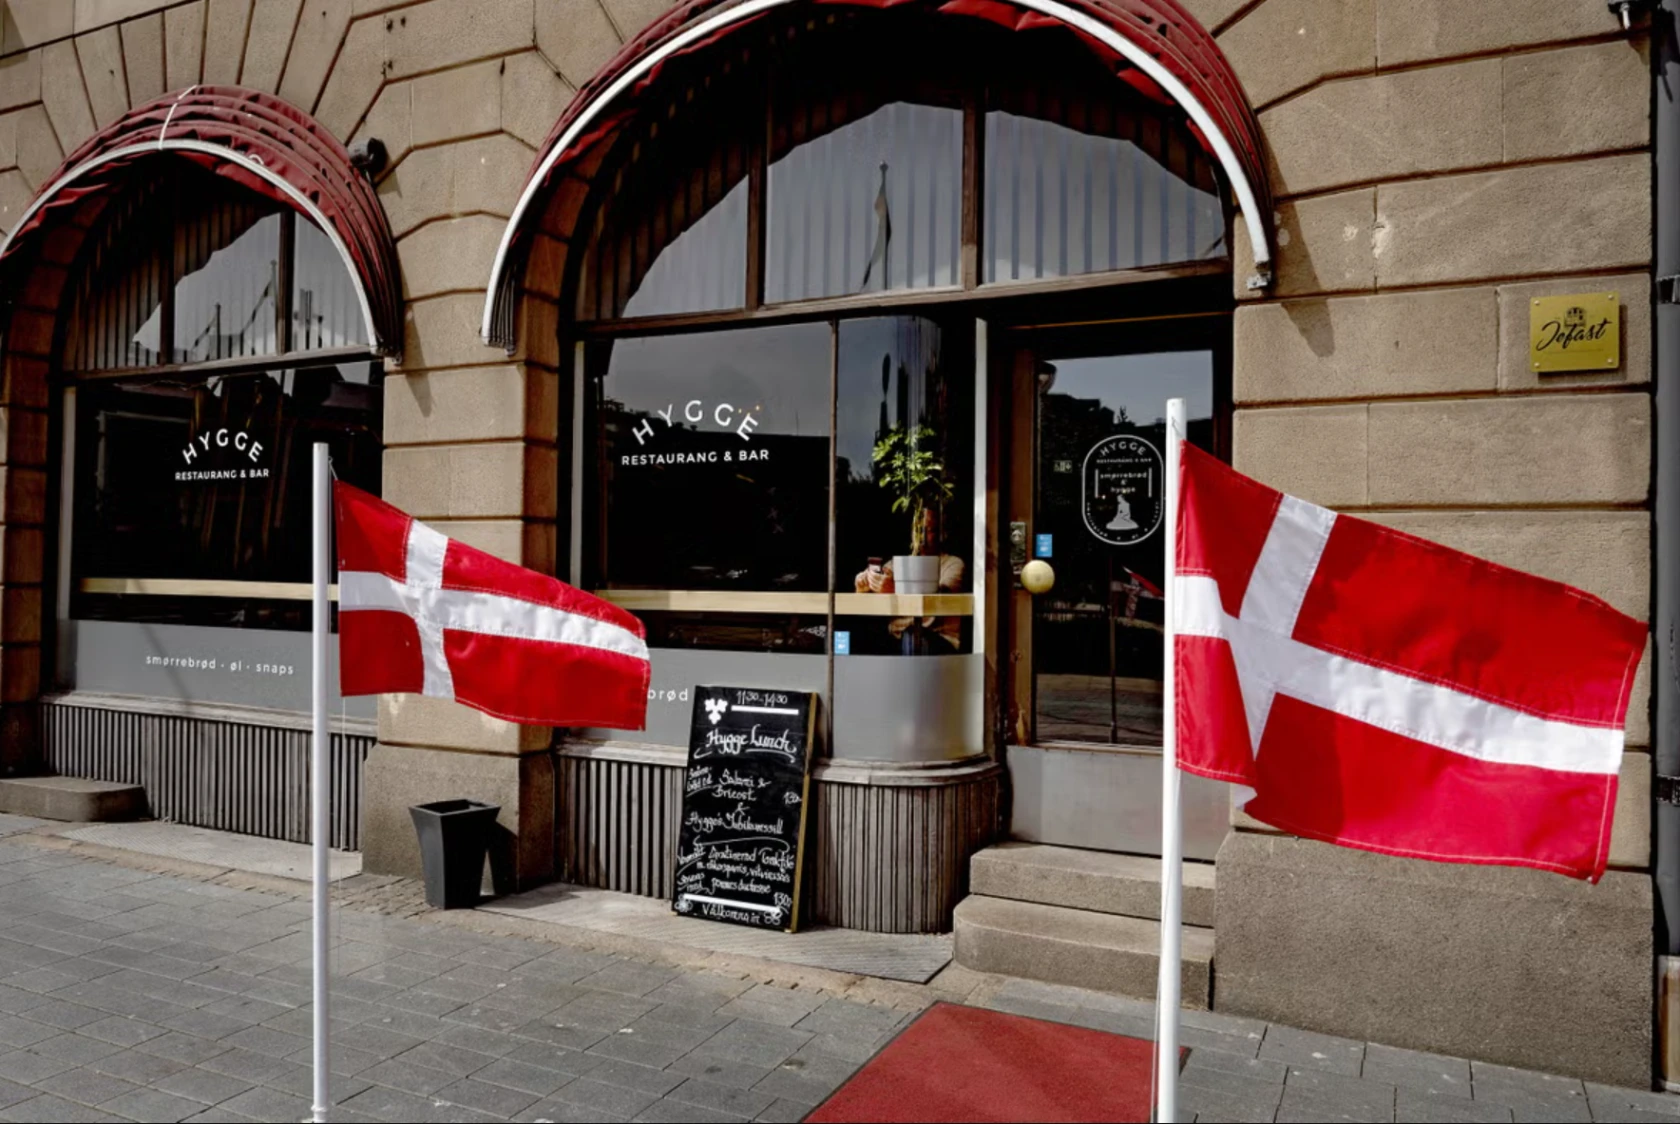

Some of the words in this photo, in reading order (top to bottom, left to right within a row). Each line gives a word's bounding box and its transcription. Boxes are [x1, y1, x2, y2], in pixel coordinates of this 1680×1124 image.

[631, 399, 759, 445] HYGGE
[182, 428, 264, 465] HYGGE
[621, 451, 718, 465] RESTAURANG
[724, 450, 732, 462] &
[738, 449, 770, 461] BAR
[1099, 441, 1146, 456] HYGGE
[174, 470, 238, 481] RESTAURANG
[239, 469, 247, 478] &
[249, 468, 270, 478] BAR
[145, 655, 217, 670] smørrebrød
[230, 661, 243, 672] øl
[255, 663, 294, 677] snaps
[704, 728, 749, 755] Hygge
[750, 724, 798, 753] Lunch
